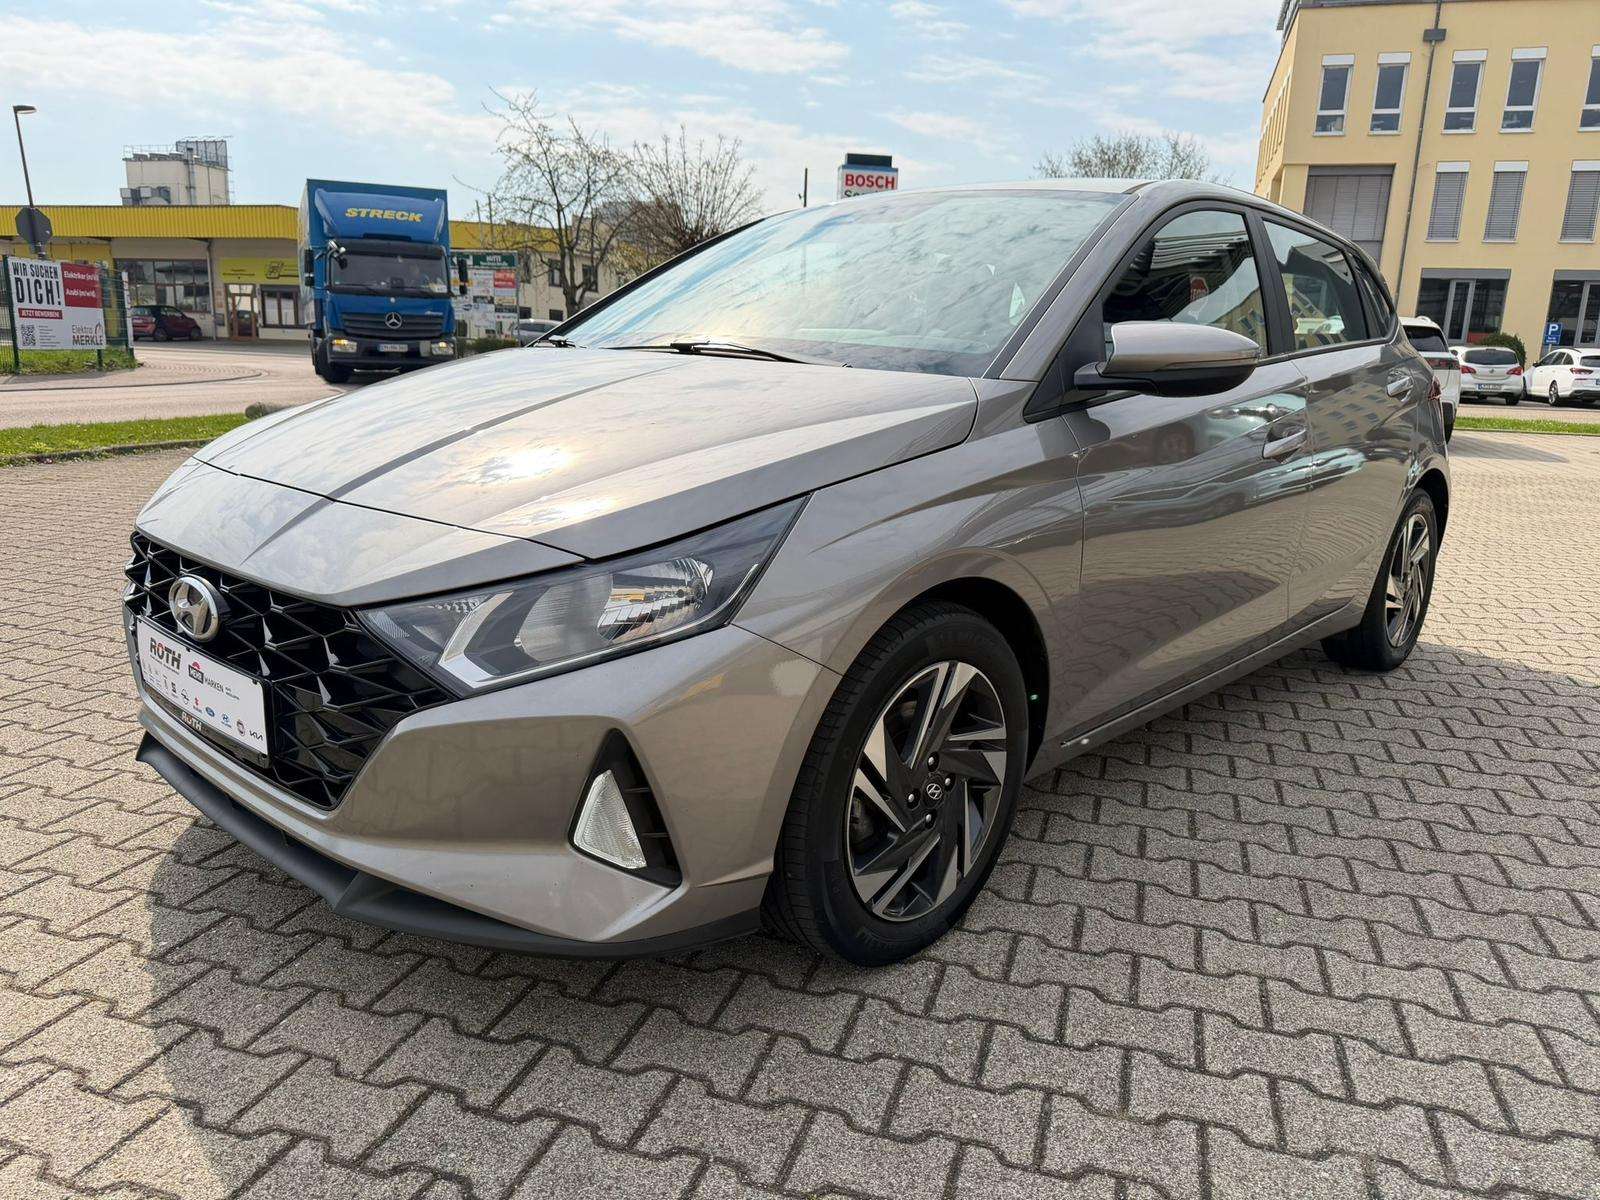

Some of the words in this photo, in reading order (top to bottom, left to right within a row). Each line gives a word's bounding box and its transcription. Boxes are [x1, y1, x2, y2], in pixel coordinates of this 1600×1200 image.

[845, 174, 895, 189] BOSCH
[345, 207, 424, 223] STRECK
[12, 262, 28, 276] WIR
[30, 263, 59, 279] SUCHEN
[15, 278, 61, 305] DICH!
[1548, 324, 1558, 335] P
[72, 335, 103, 346] MERKLE
[150, 637, 182, 670] ROTH
[181, 711, 202, 732] ROTH
